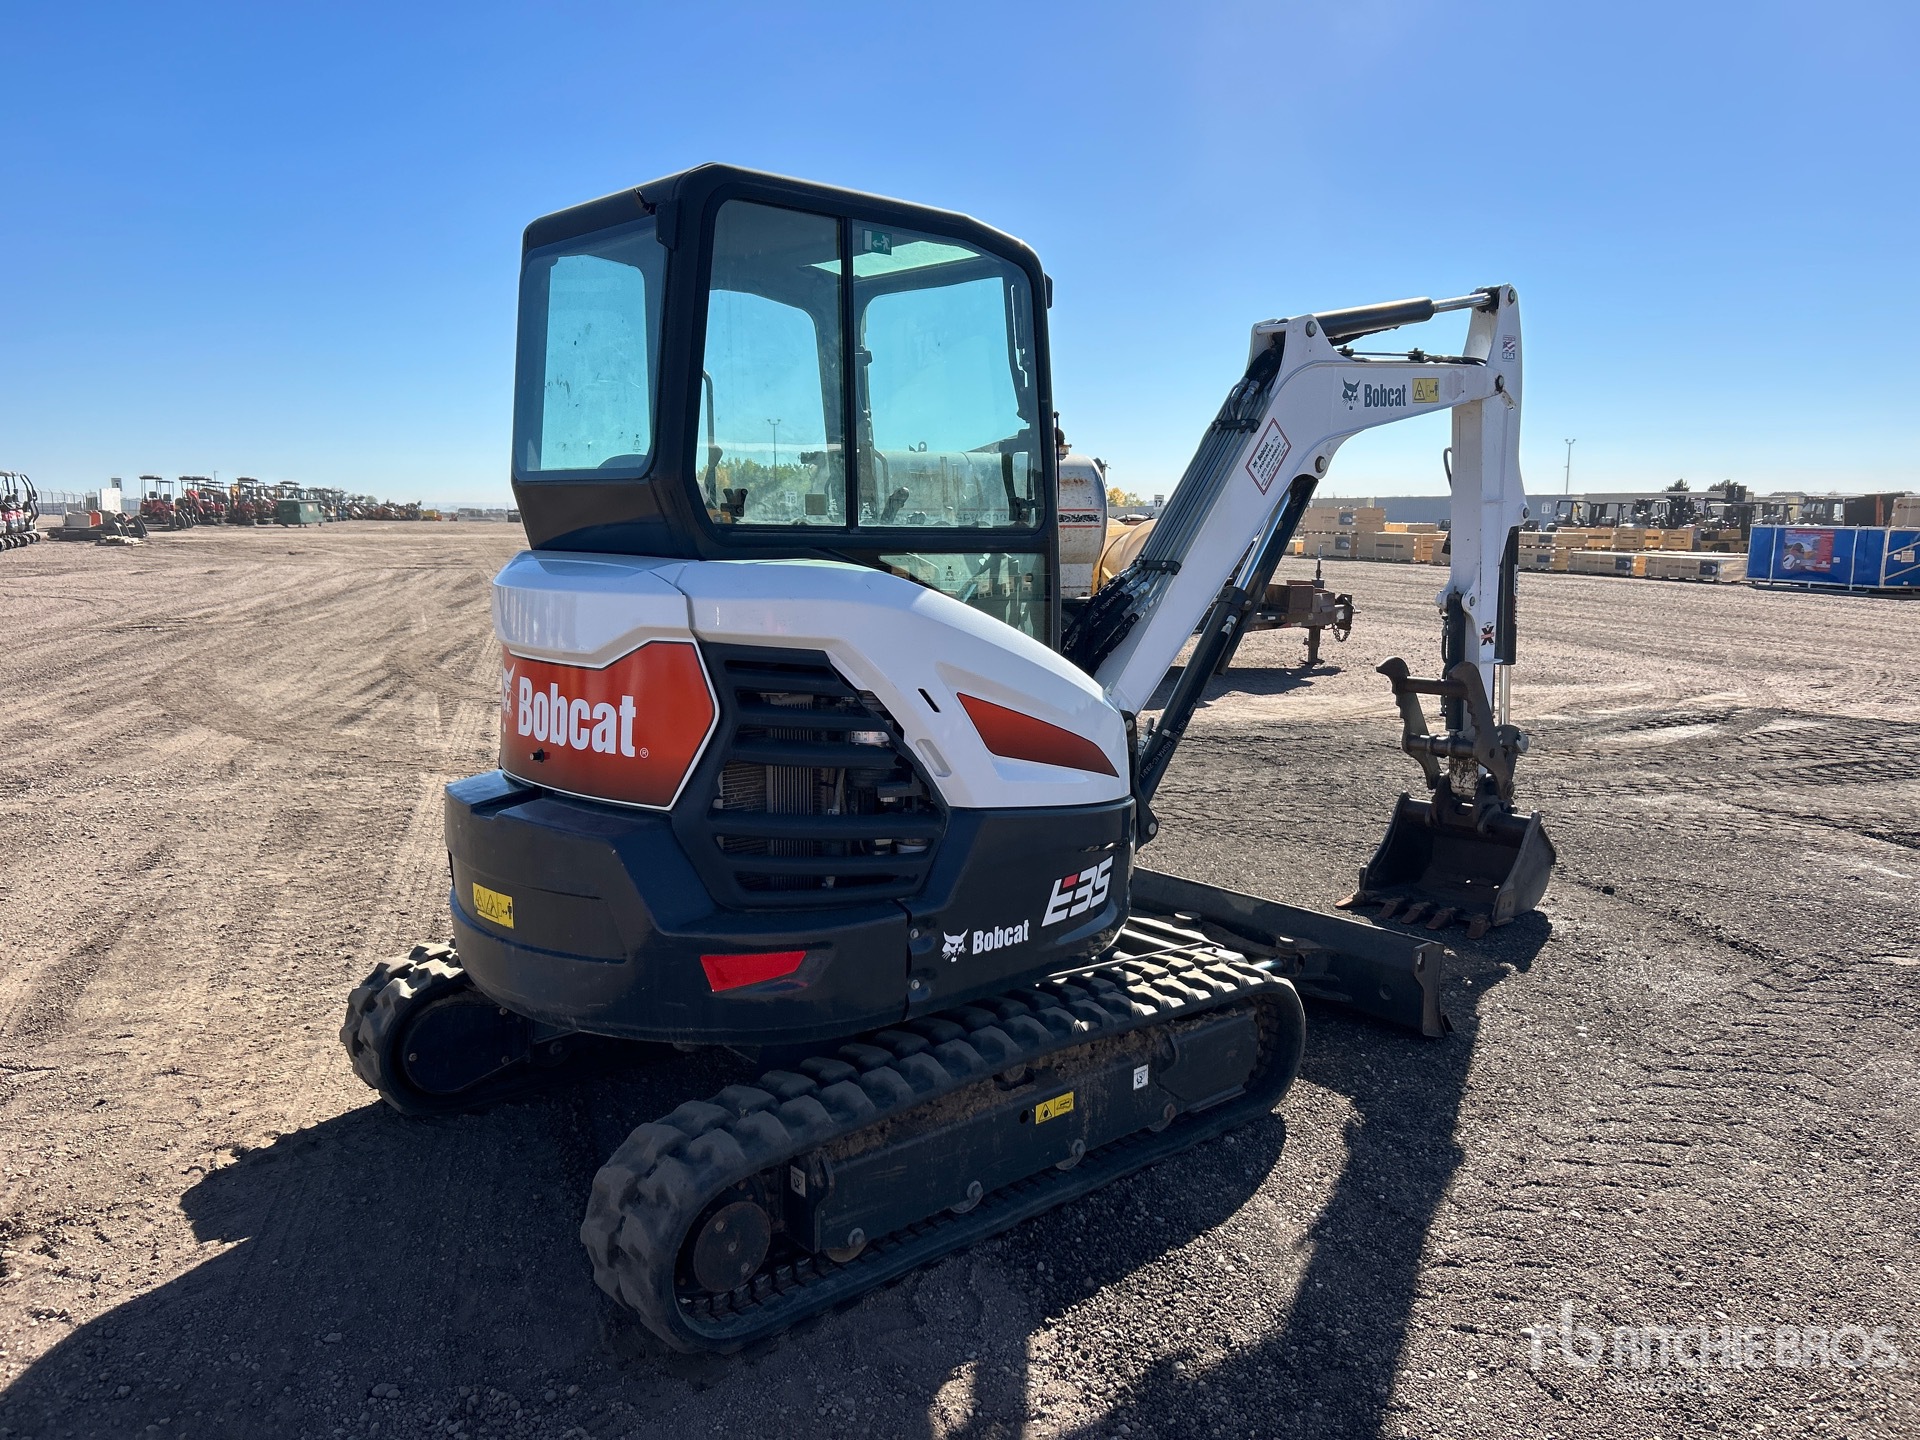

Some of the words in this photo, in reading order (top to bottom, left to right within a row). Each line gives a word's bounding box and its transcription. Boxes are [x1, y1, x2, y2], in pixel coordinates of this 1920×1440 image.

[1364, 384, 1406, 407] Bobcat
[518, 676, 636, 758] Bobcat
[1041, 855, 1114, 927] E35
[972, 919, 1029, 954] Bobcat
